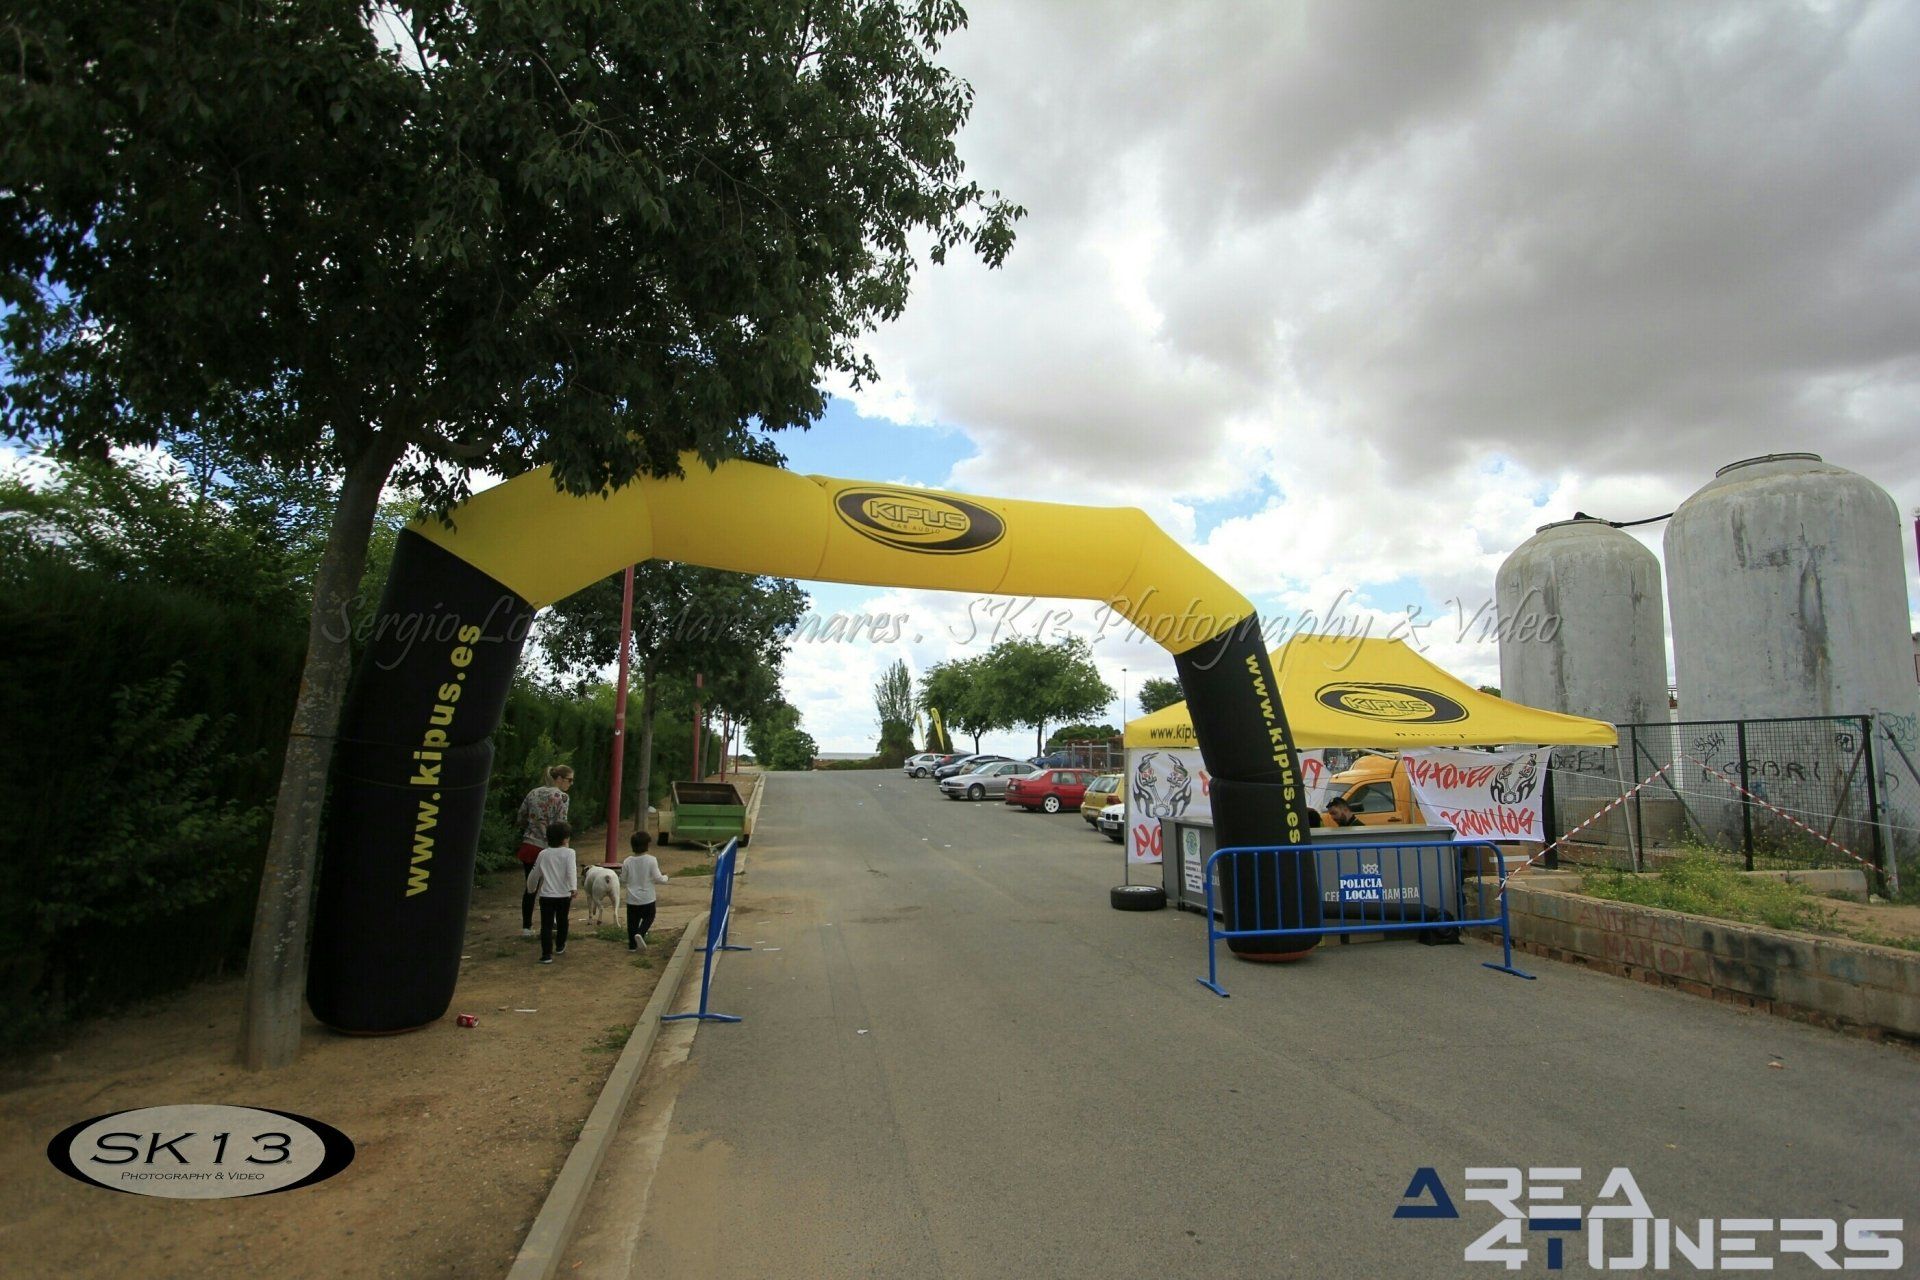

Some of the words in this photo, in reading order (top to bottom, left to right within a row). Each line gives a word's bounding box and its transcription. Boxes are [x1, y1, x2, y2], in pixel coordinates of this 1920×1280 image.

[869, 500, 967, 531] KIPUS
[1344, 697, 1433, 713] KIPUS
[406, 624, 481, 897] www.kipus.es
[1245, 654, 1300, 844] www.kipus.es
[1340, 878, 1383, 889] POLICIA
[1345, 889, 1379, 900] LOCAL
